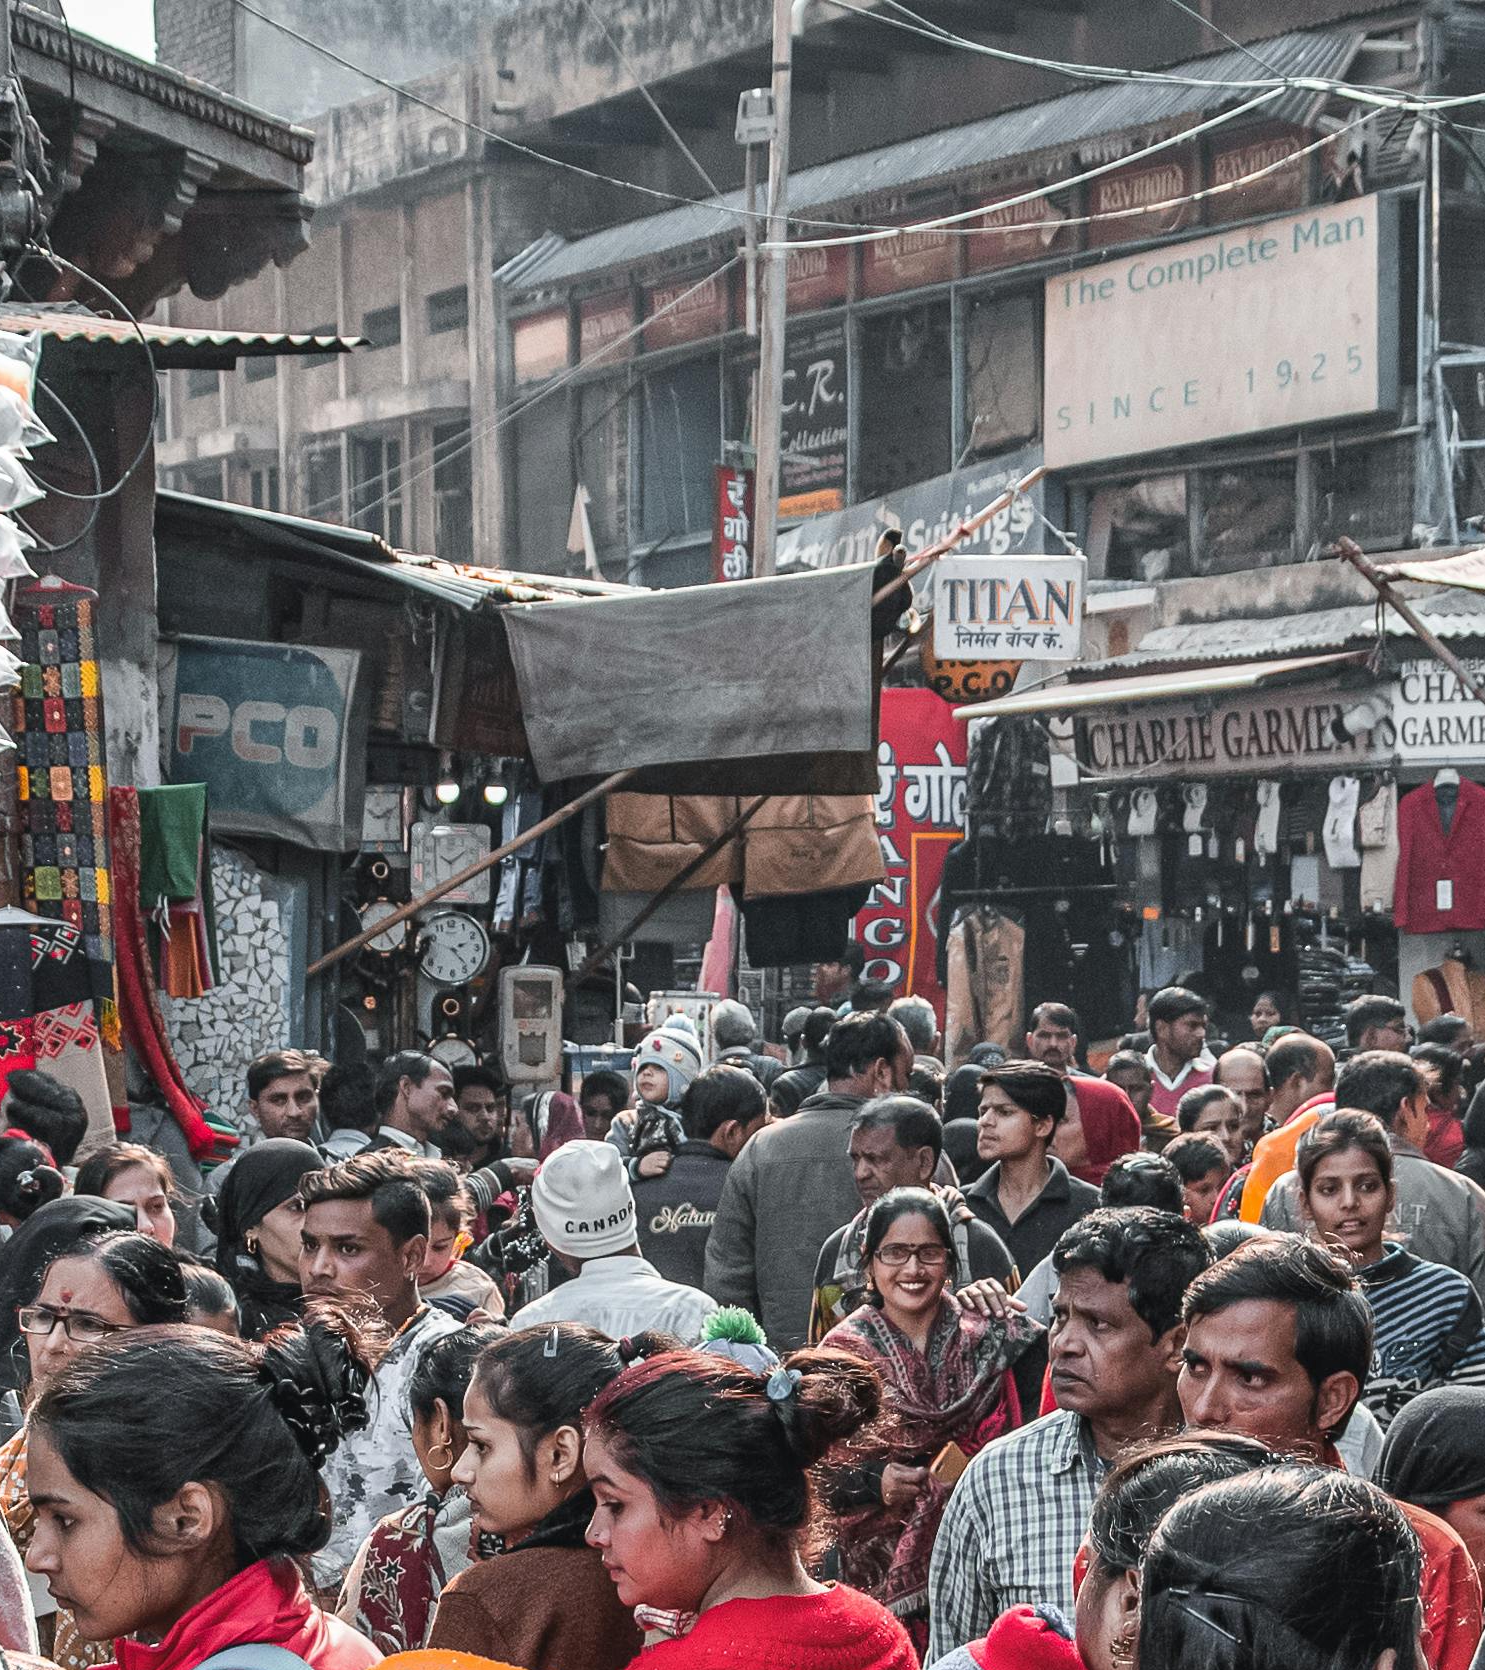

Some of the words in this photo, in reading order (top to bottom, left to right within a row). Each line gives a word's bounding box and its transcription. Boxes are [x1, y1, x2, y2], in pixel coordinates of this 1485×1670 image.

[1062, 275, 1115, 309] The
[1127, 236, 1279, 290] Complete
[1292, 213, 1366, 254] Man
[1057, 379, 1201, 431] SINCE
[1244, 345, 1364, 394] 1925
[942, 576, 1076, 625] TITAN
[954, 624, 1002, 649] निर्मल
[177, 693, 340, 769] PCO
[1090, 713, 1216, 770] CHARLIE
[565, 1200, 633, 1234] CANADA
